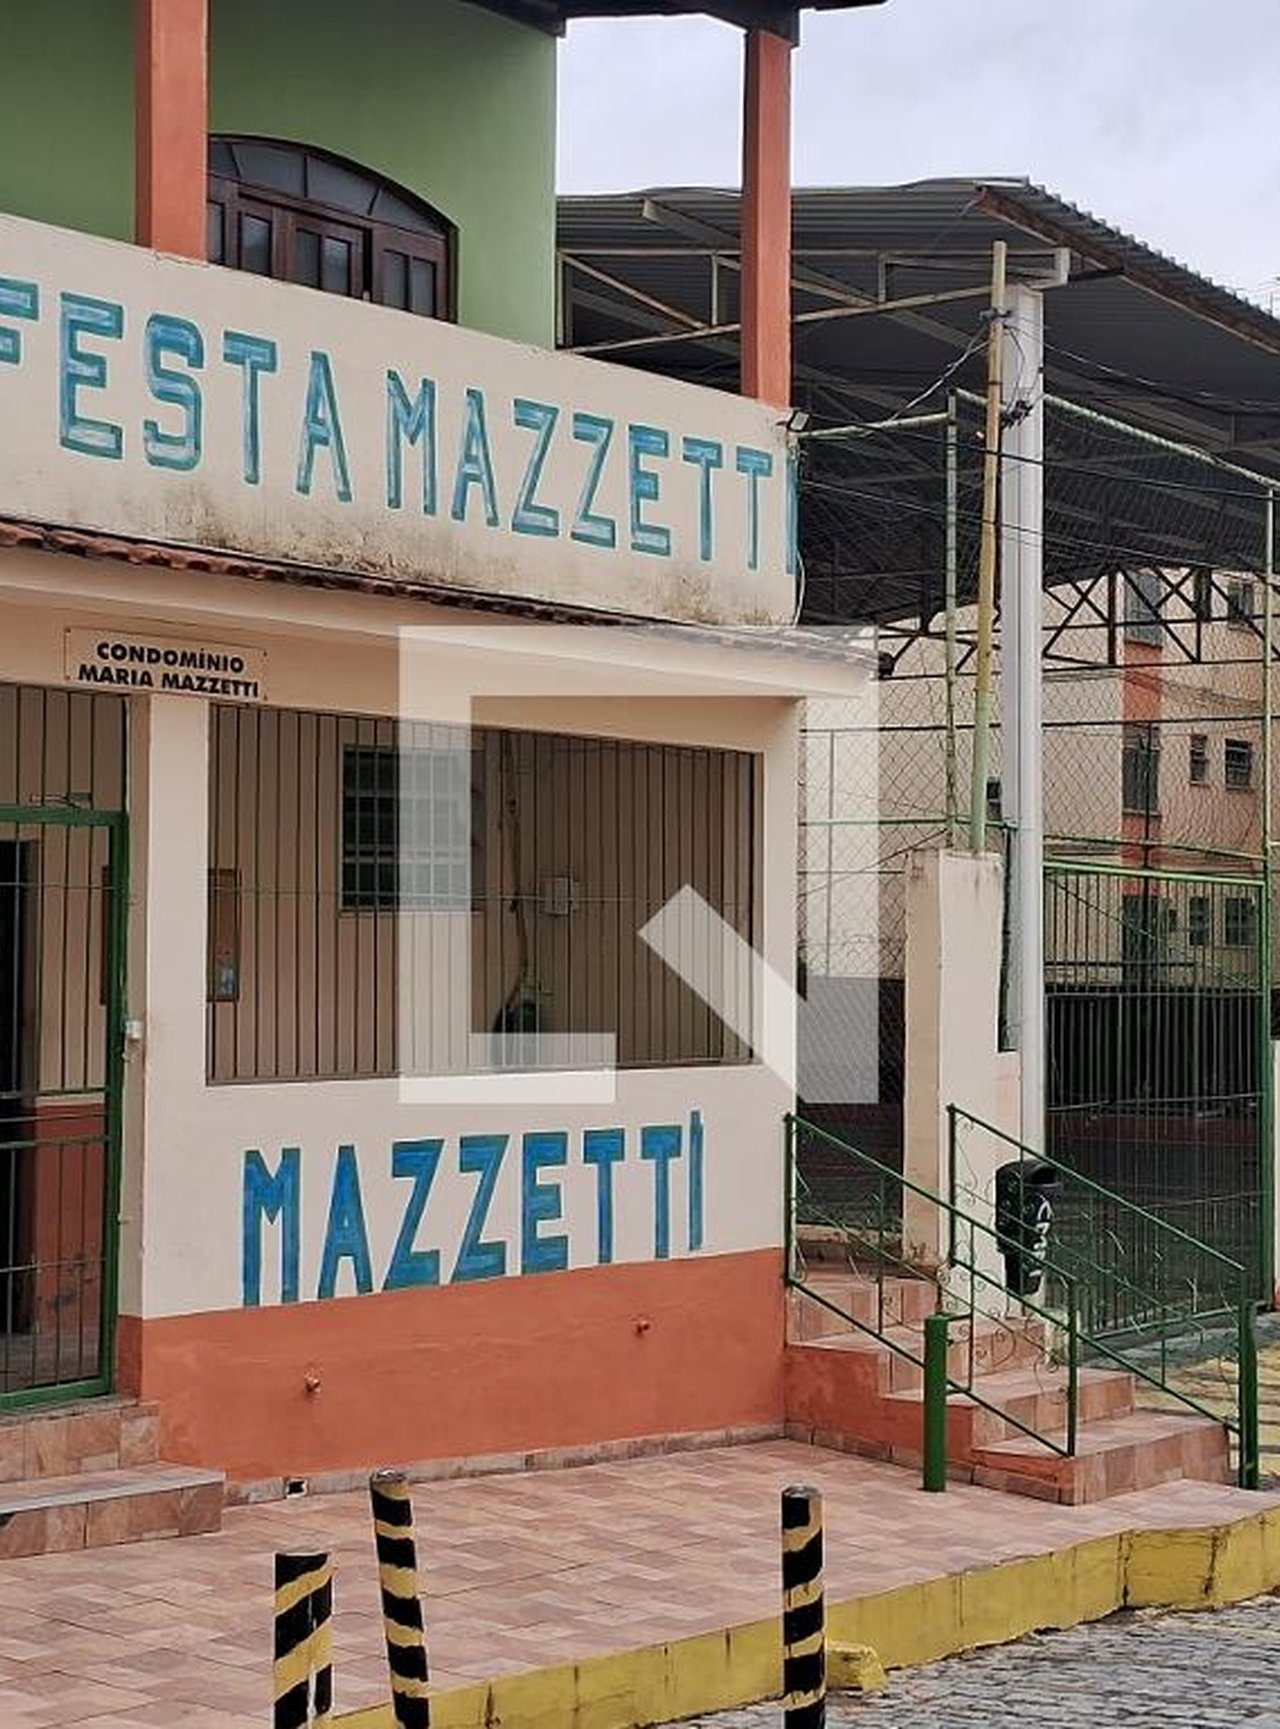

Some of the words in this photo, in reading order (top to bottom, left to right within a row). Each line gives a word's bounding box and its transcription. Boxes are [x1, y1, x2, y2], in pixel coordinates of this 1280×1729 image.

[386, 368, 800, 578] MAZZETTI
[78, 663, 154, 688] MARIA
[161, 673, 259, 698] MAZZETTI
[96, 642, 245, 674] CONDOMÍNIO
[242, 1108, 704, 1308] MAZZETTI
